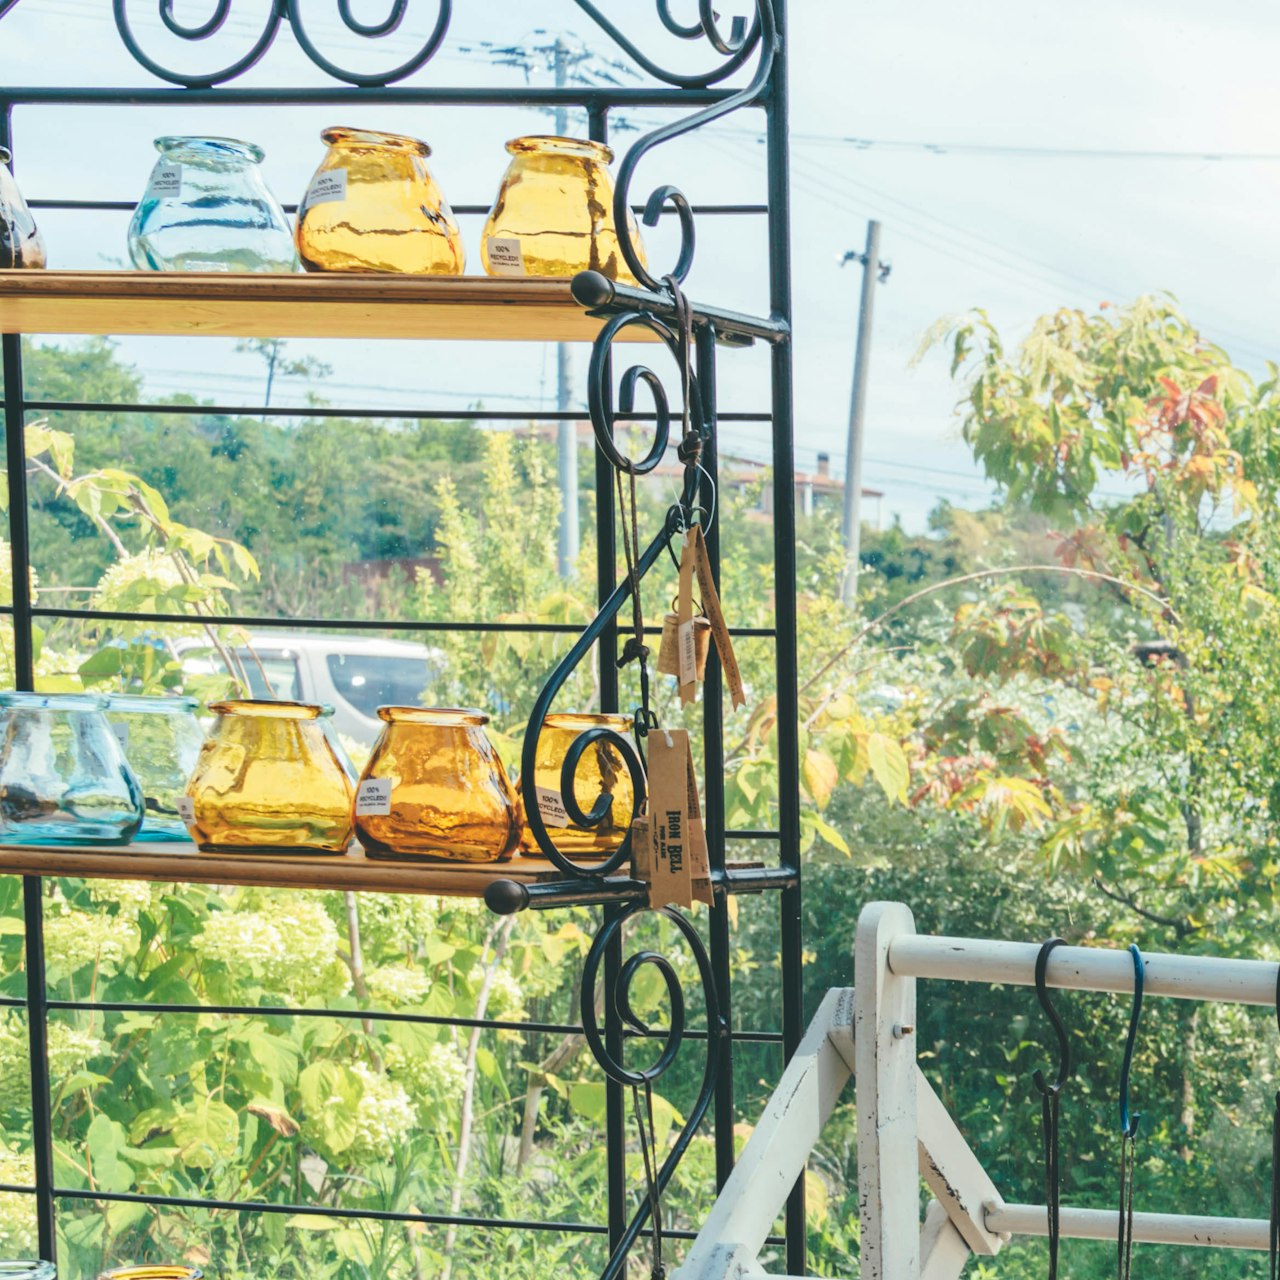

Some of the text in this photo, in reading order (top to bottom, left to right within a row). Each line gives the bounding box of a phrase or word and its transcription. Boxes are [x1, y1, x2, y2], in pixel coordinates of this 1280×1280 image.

[542, 795, 559, 804] 100%
[666, 810, 682, 874] IRON BELL
